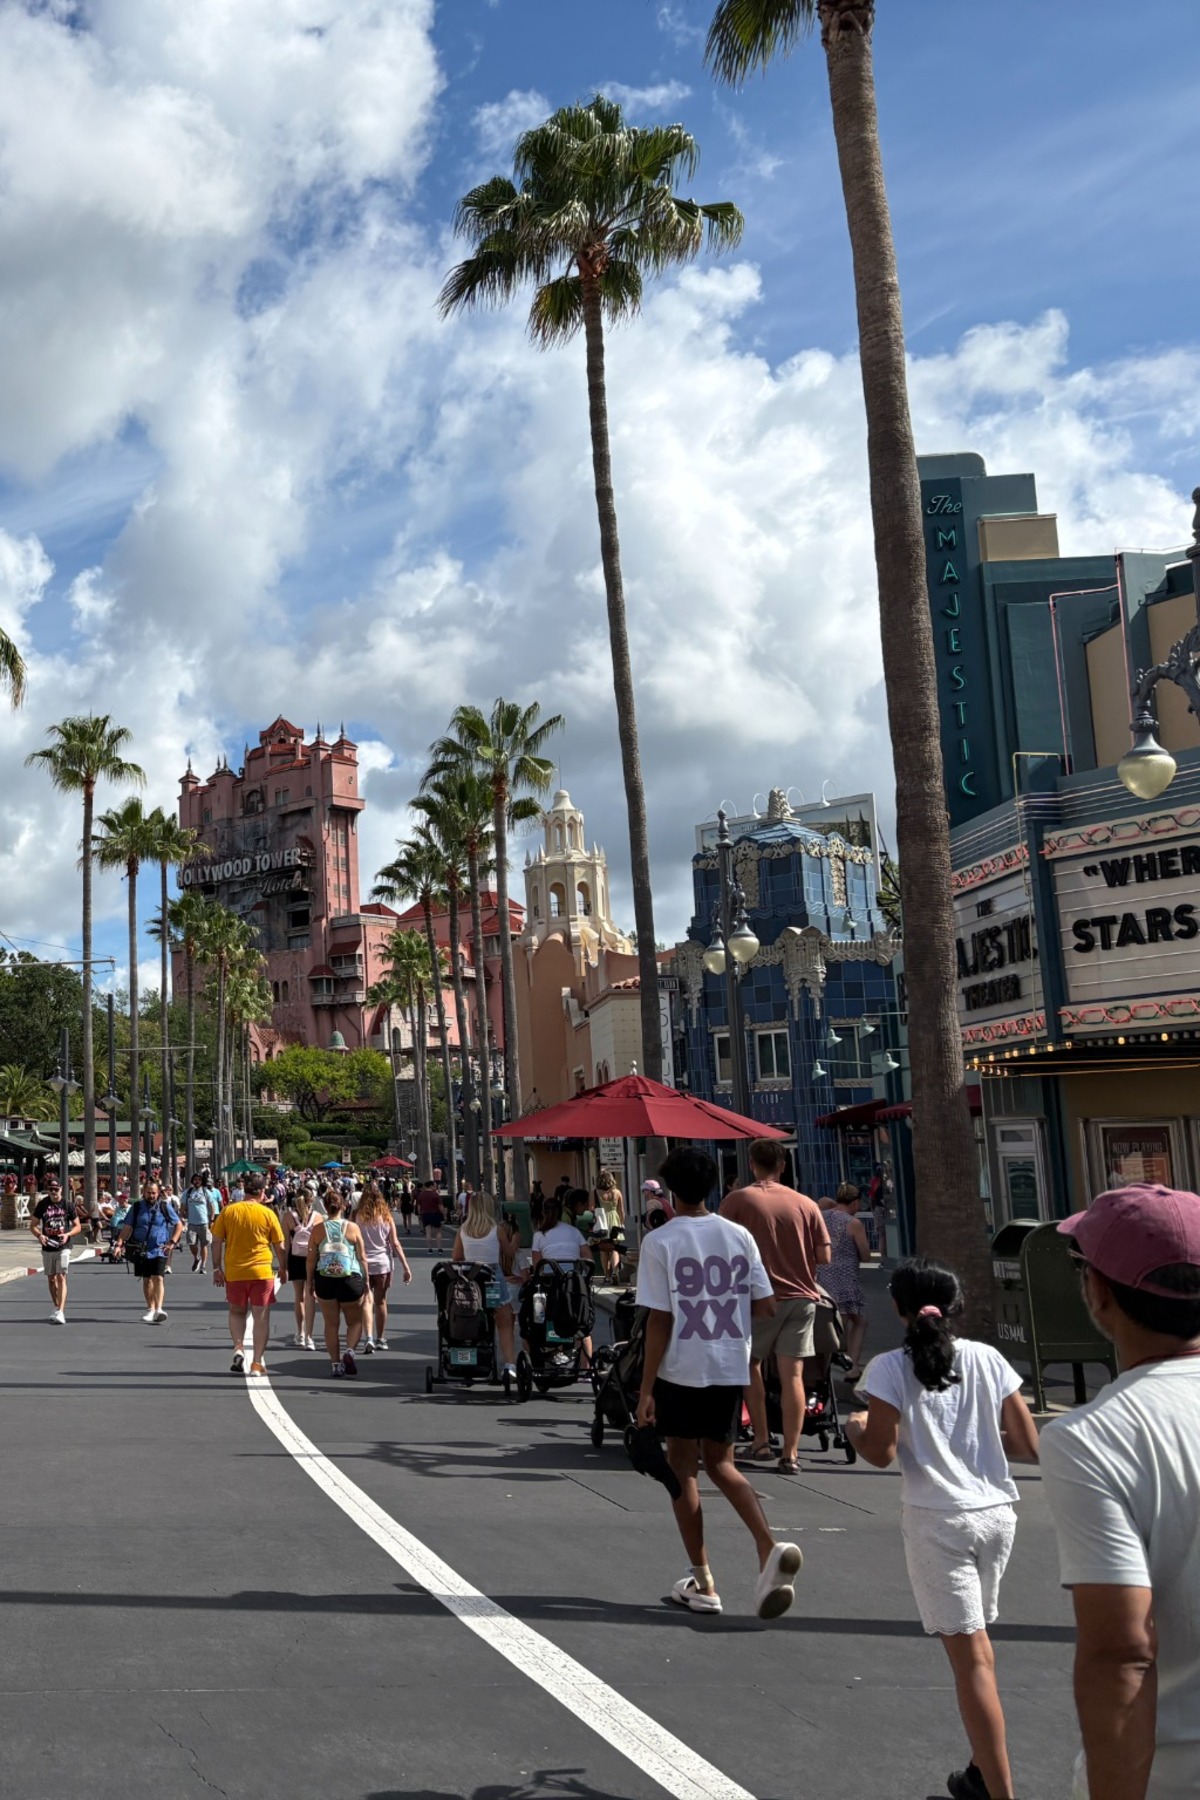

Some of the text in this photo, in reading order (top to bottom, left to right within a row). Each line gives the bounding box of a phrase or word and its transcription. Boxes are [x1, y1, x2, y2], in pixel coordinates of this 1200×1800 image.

[927, 494, 962, 515] The
[936, 526, 978, 798] MAJESTIC
[176, 848, 301, 887] HOLLYWOOD TOWER
[956, 914, 1038, 980] AJESTIC
[1072, 904, 1198, 953] STARS
[962, 973, 1021, 1011] THEATER
[1112, 1142, 1163, 1153] NOW PLAYING
[678, 1299, 743, 1340] XX
